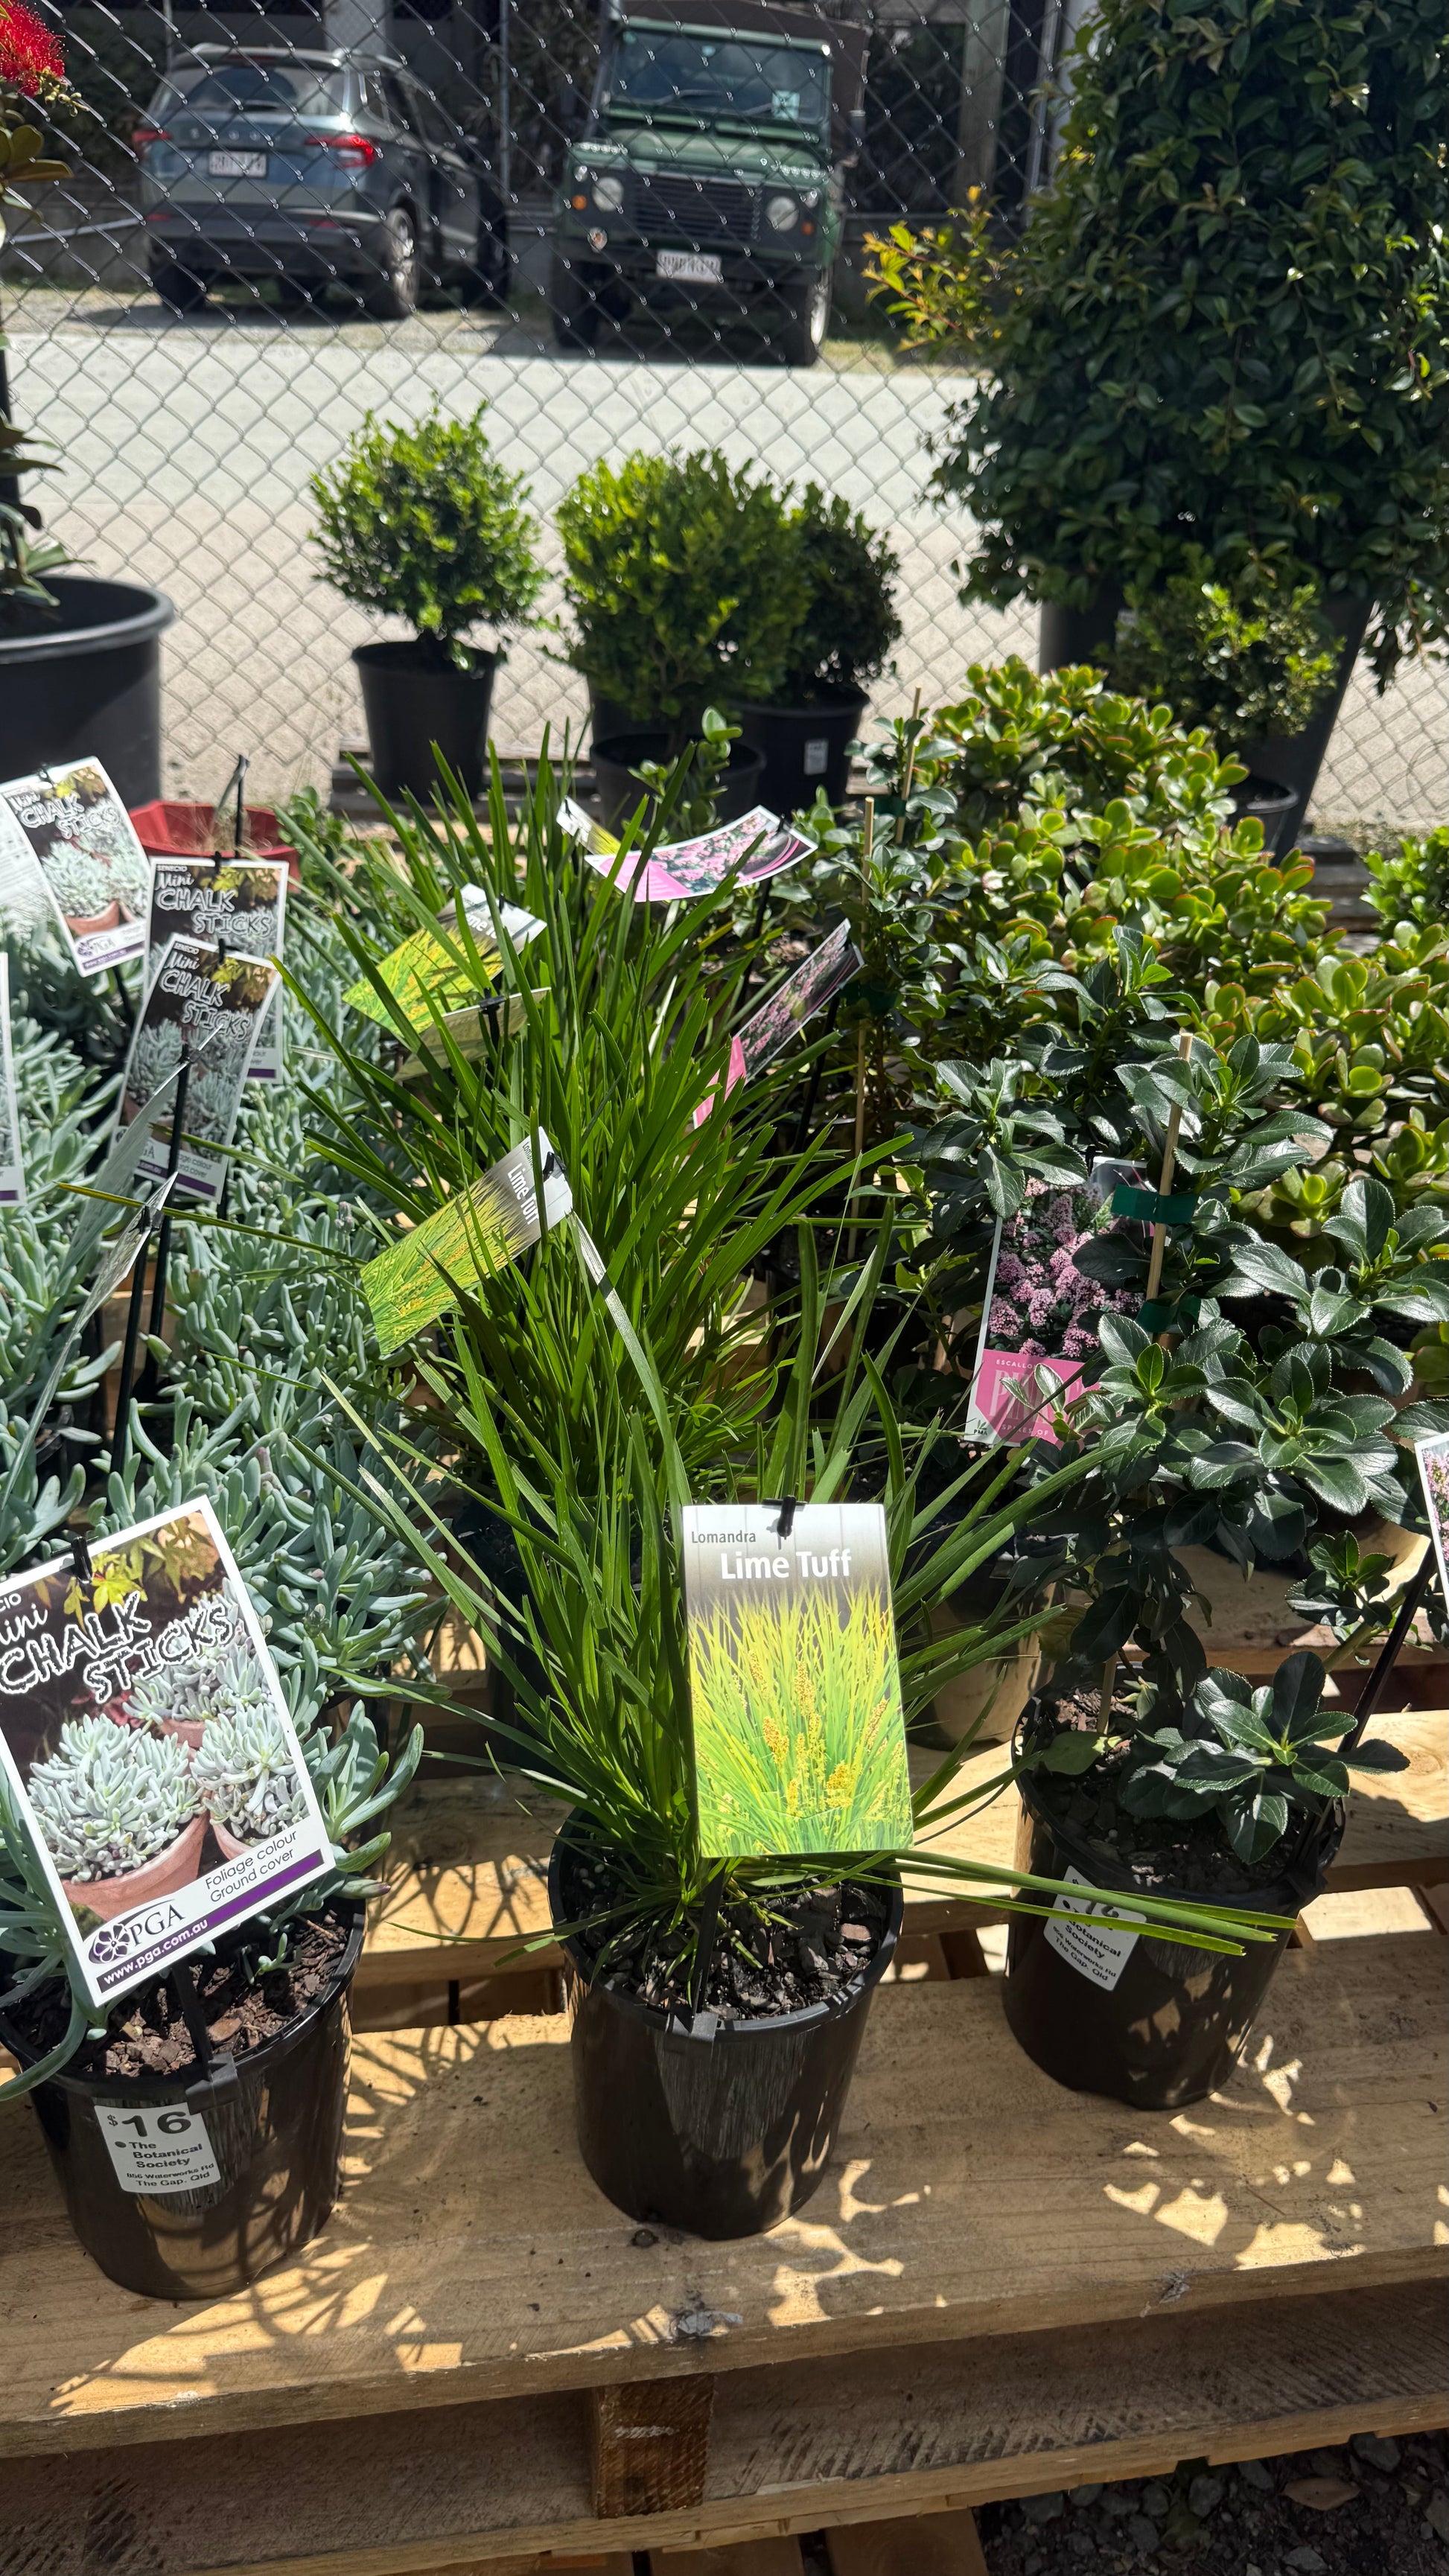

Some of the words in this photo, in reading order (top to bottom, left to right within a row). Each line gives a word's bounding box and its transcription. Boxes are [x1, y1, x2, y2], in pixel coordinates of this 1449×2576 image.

[154, 887, 235, 912] CHALK
[191, 910, 273, 938] STICKS
[159, 969, 231, 1007] CHALK
[181, 998, 251, 1040] STICKS
[508, 1163, 529, 1200] Lime
[996, 1359, 1036, 1369] ESCALLO
[691, 1530, 757, 1543] Lomandra
[720, 1551, 790, 1579] Lime
[795, 1549, 852, 1578] Tuff
[0, 1603, 48, 1645] ini
[0, 1590, 152, 1695] CHALK
[83, 1603, 235, 1704] STICKS
[206, 1858, 254, 1890] Foliage
[257, 1830, 298, 1860] colour
[210, 1869, 258, 1903] Ground
[259, 1847, 295, 1876] cover
[128, 1904, 186, 1947] PGA
[1065, 1925, 1105, 1958] Society
[104, 1918, 209, 1985] www.pga.com.au
[1054, 1937, 1069, 1953] The
[1092, 1969, 1109, 1980] Qld
[107, 2111, 191, 2137] $16
[129, 2141, 156, 2149] The
[133, 2143, 203, 2159] Botanical
[136, 2158, 191, 2168] Society
[145, 2167, 200, 2179] Waterworks
[190, 2172, 210, 2181] Qld
